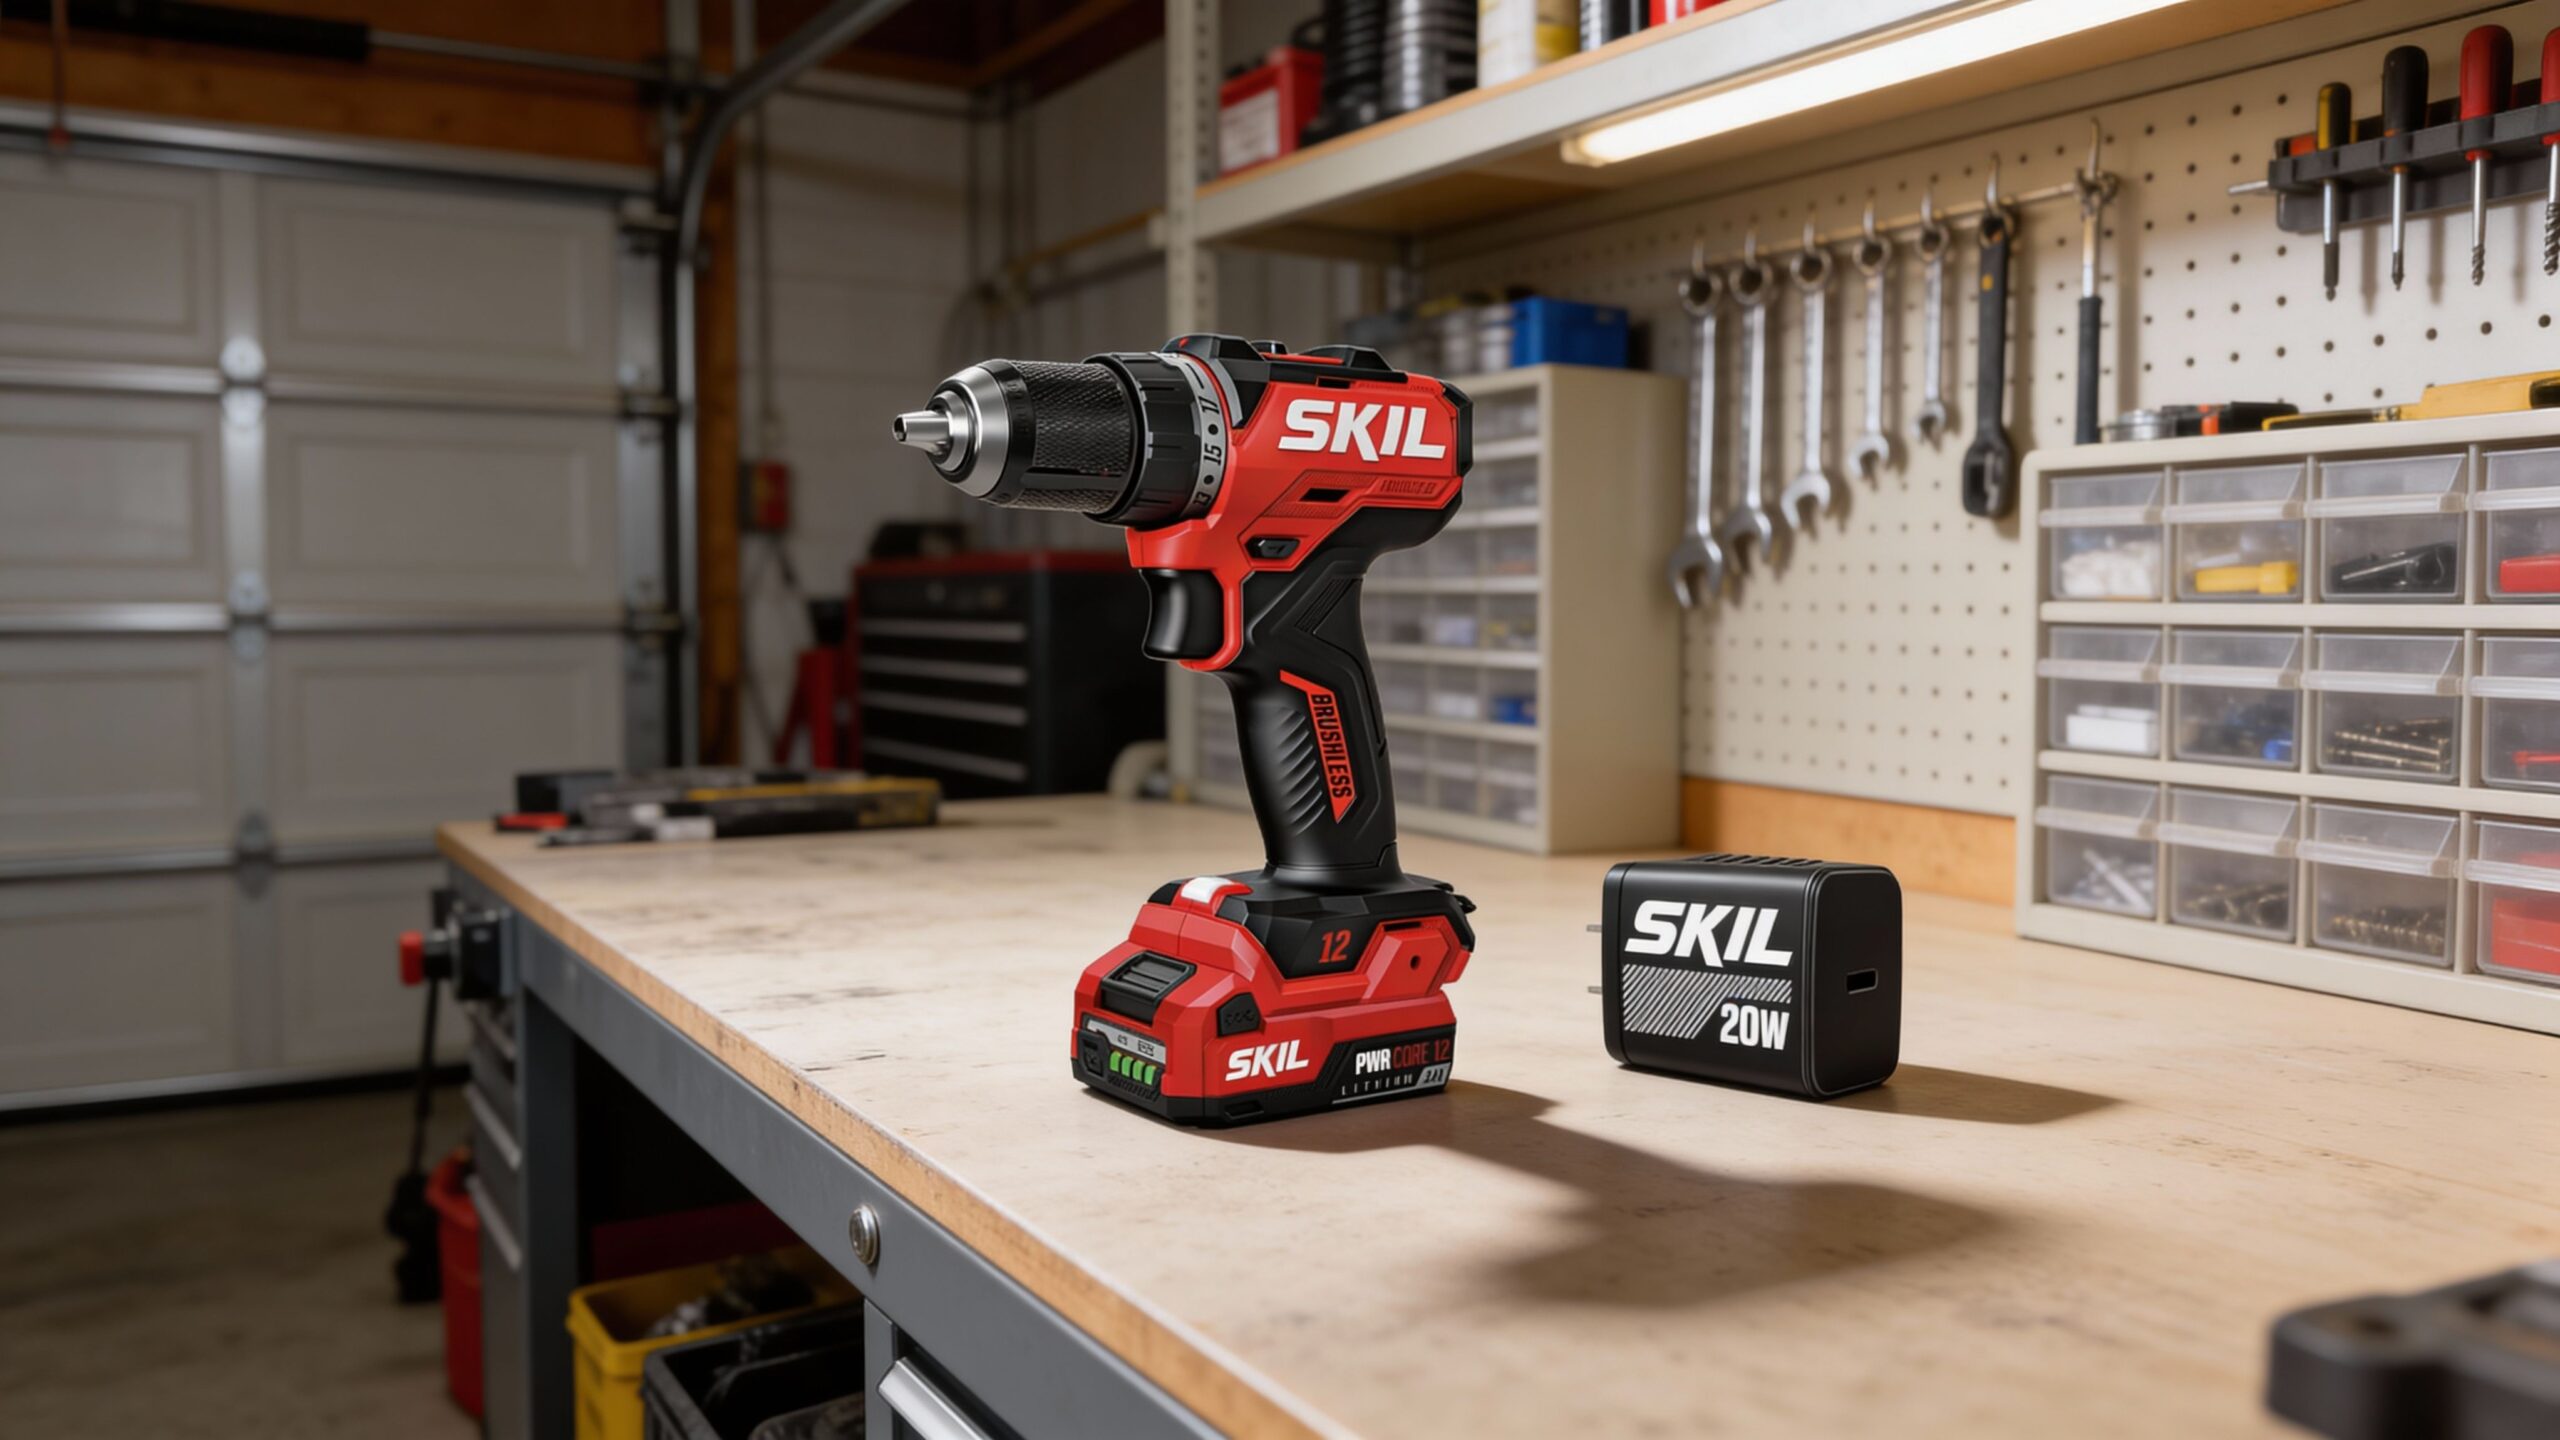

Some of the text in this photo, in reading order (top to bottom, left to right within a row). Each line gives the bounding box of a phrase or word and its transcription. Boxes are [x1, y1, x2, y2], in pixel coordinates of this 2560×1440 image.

[1278, 399, 1446, 462] SKIL
[1203, 443, 1222, 466] 15
[1311, 694, 1351, 798] BRUSHLESS
[1319, 929, 1352, 963] 12
[1624, 900, 1793, 967] SKIL
[1719, 1003, 1790, 1050] 20W
[1225, 1039, 1309, 1082] SKIL
